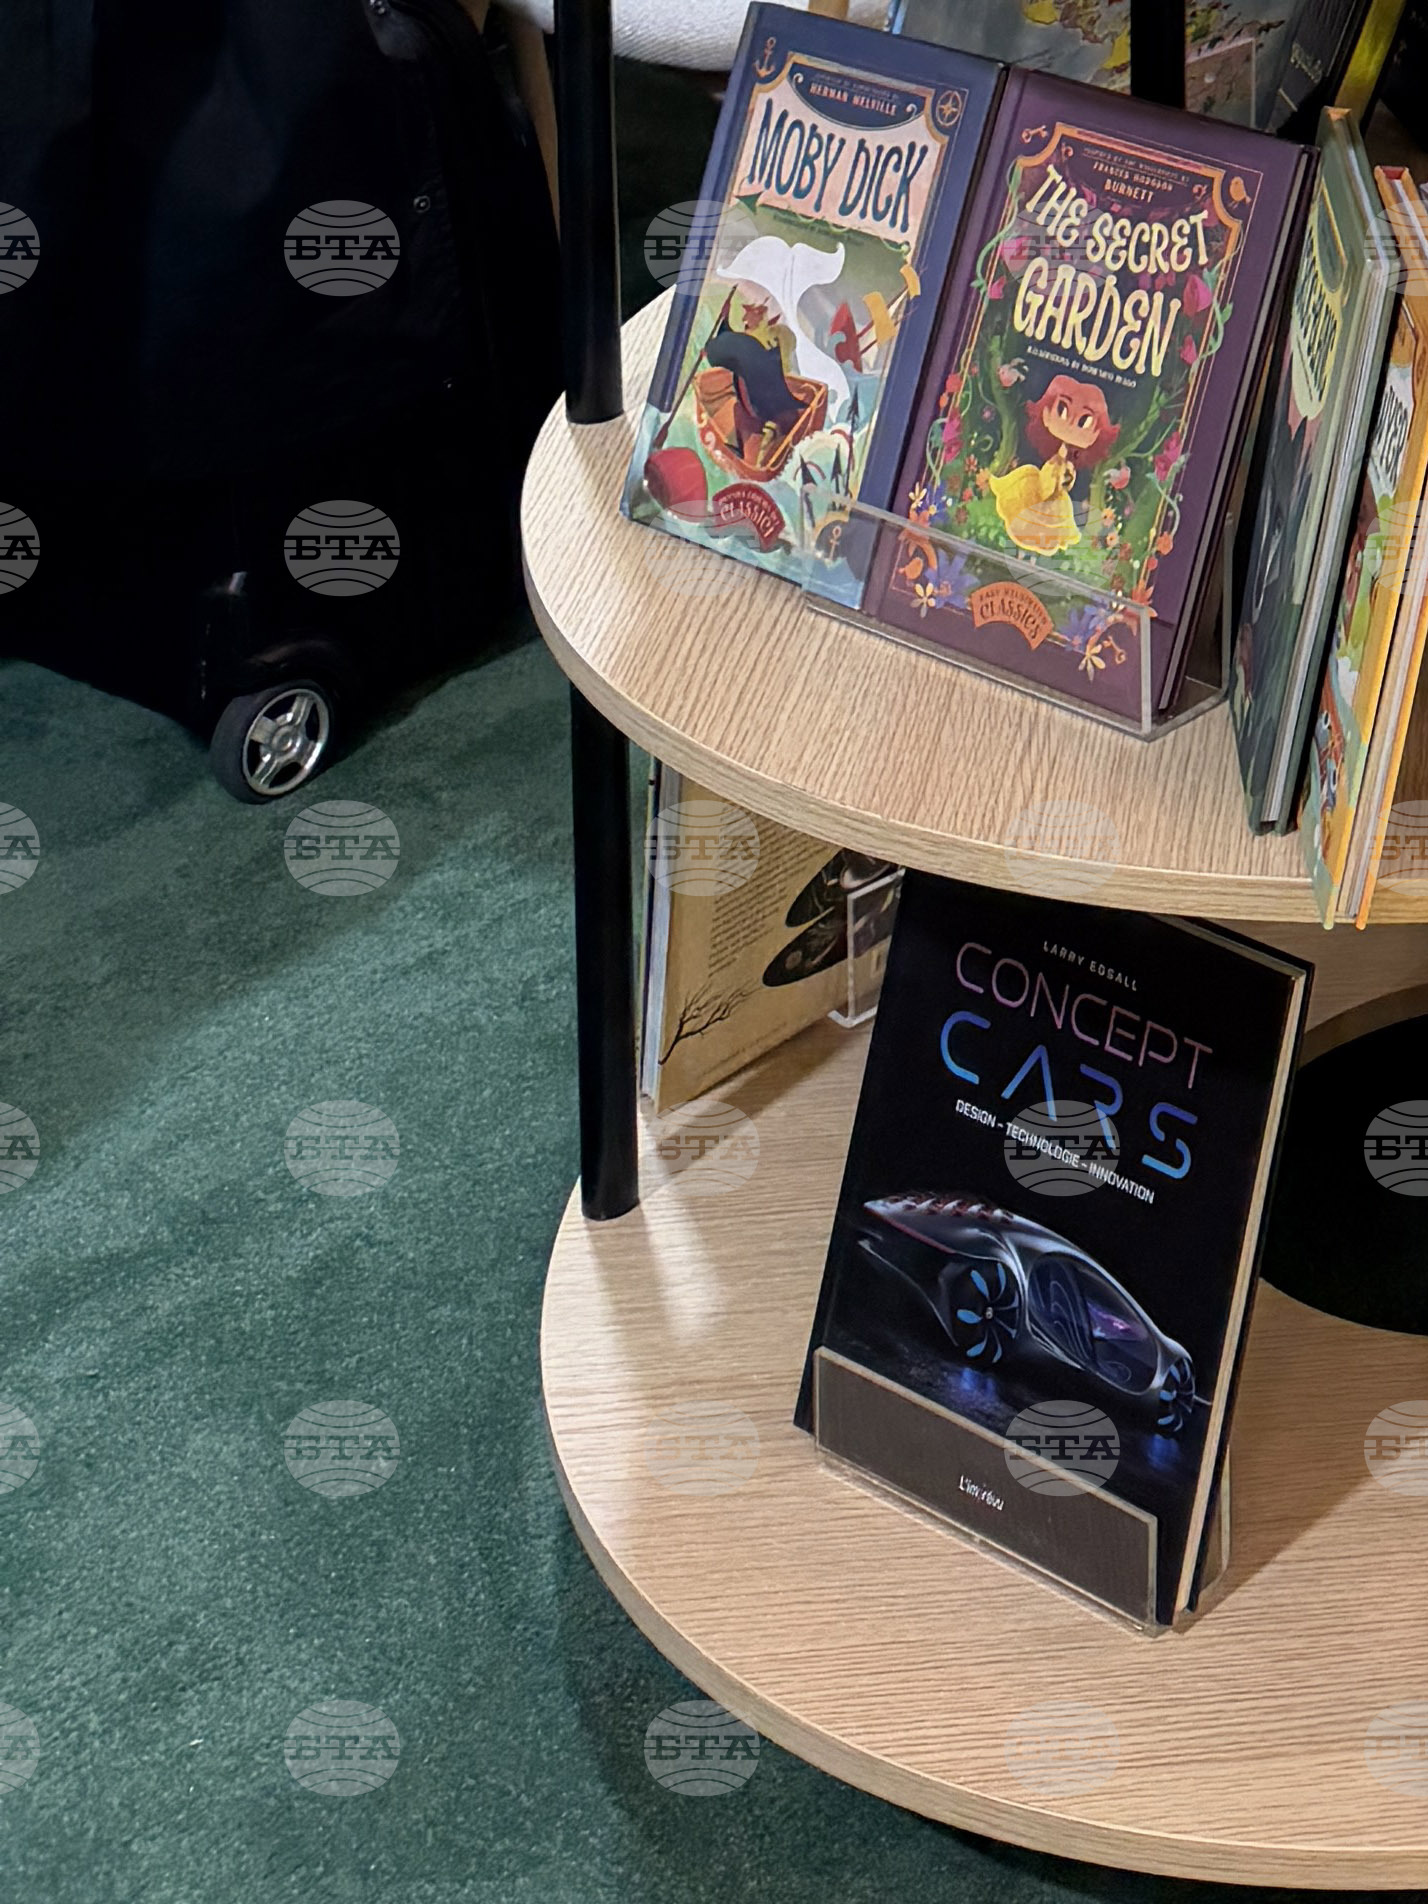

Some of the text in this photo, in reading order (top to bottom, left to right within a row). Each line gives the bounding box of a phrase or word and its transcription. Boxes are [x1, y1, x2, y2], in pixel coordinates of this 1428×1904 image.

[747, 97, 929, 234] MOBY DICK
[1025, 163, 1210, 275] THE SECRET
[1103, 178, 1155, 204] BURNETT
[1013, 256, 1183, 378] GARDEN
[1043, 940, 1085, 967] LARRY
[956, 942, 1214, 1089] CONCEPT
[940, 1010, 1199, 1180] CARS
[955, 1098, 1156, 1205] DESIGN TECHNOLOGIE INNOVATION
